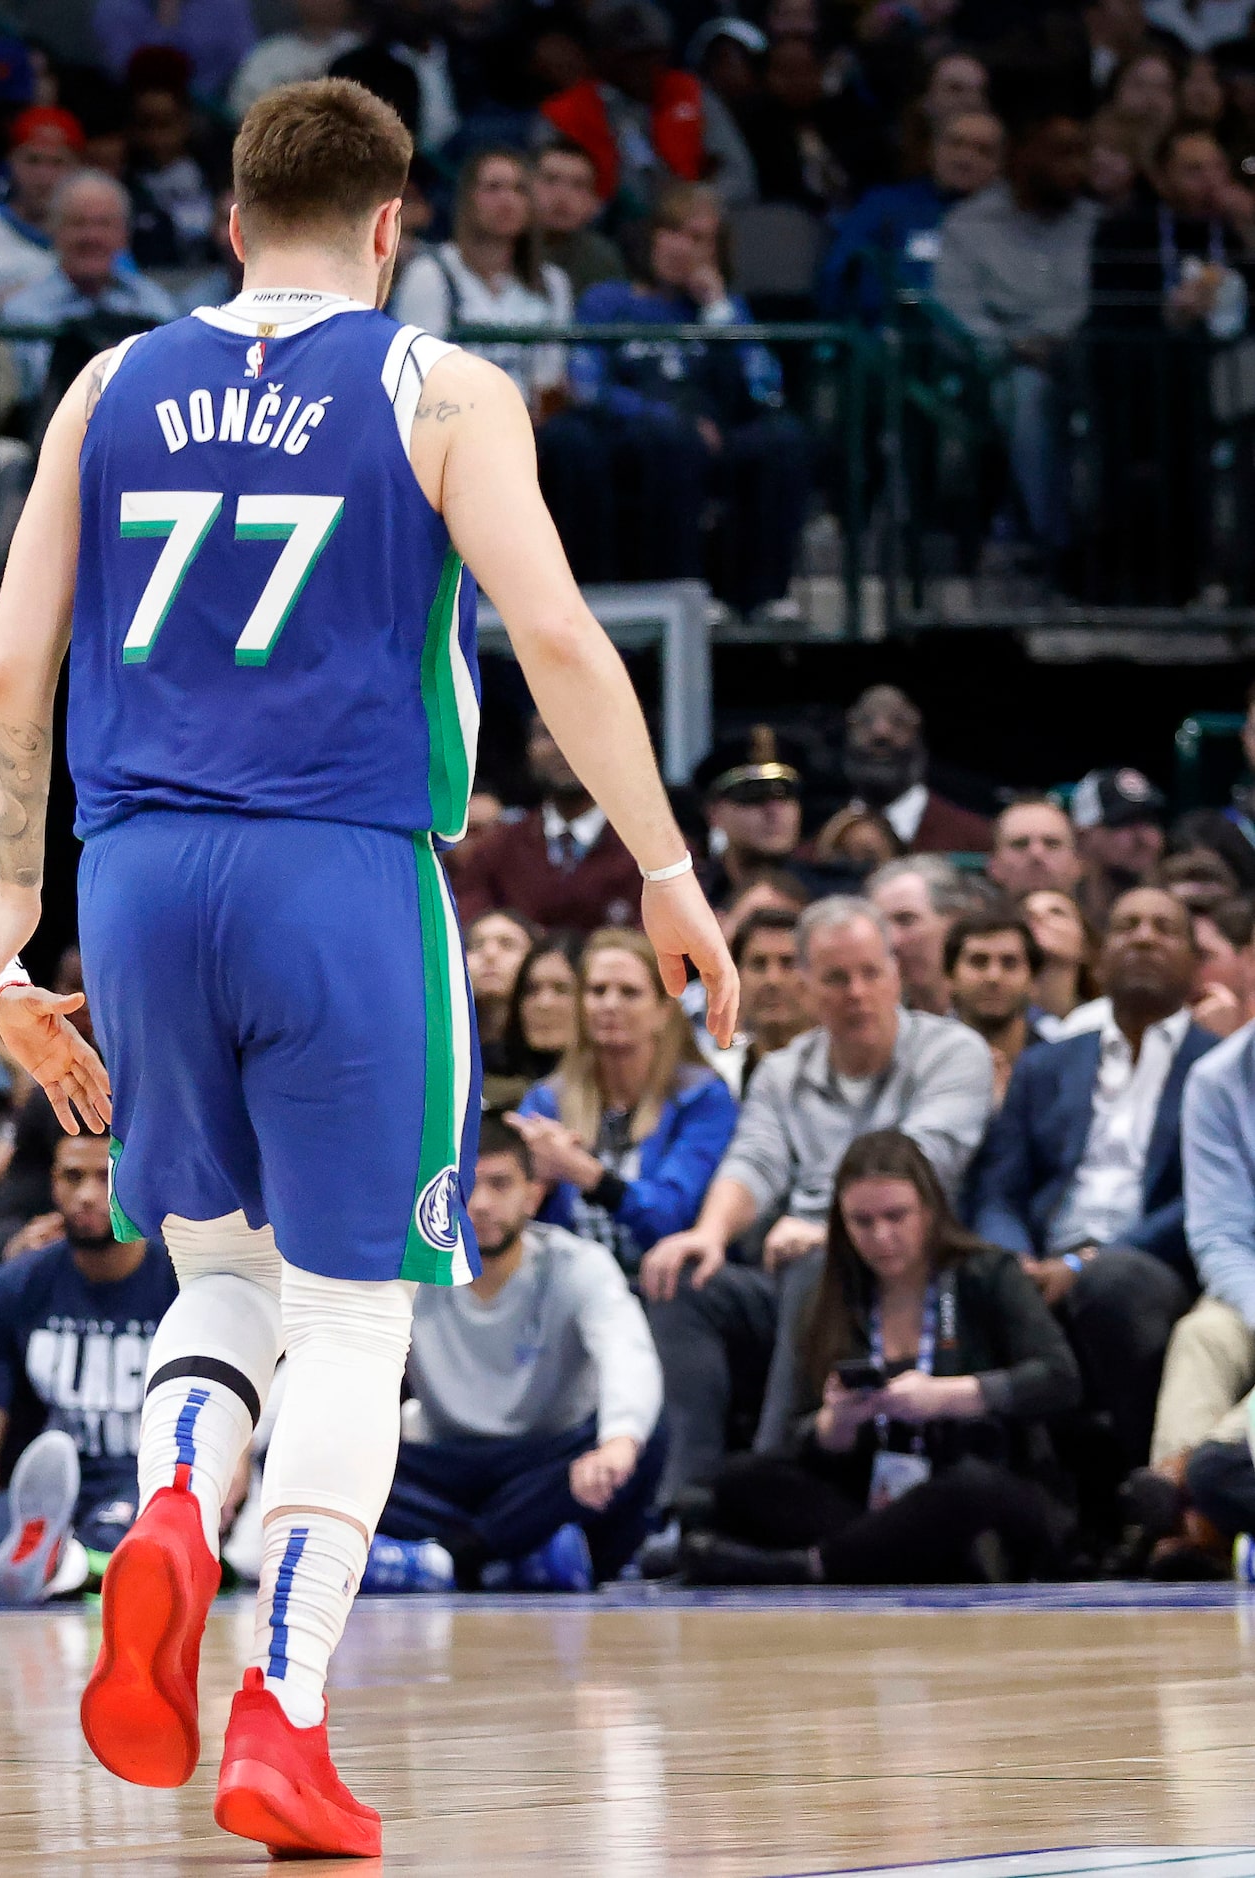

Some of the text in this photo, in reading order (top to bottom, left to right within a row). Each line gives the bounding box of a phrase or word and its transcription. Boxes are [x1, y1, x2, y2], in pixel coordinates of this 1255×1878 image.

[252, 293, 323, 303] NIKE PRO
[154, 382, 334, 456] DONČIĆ
[120, 490, 346, 667] 77
